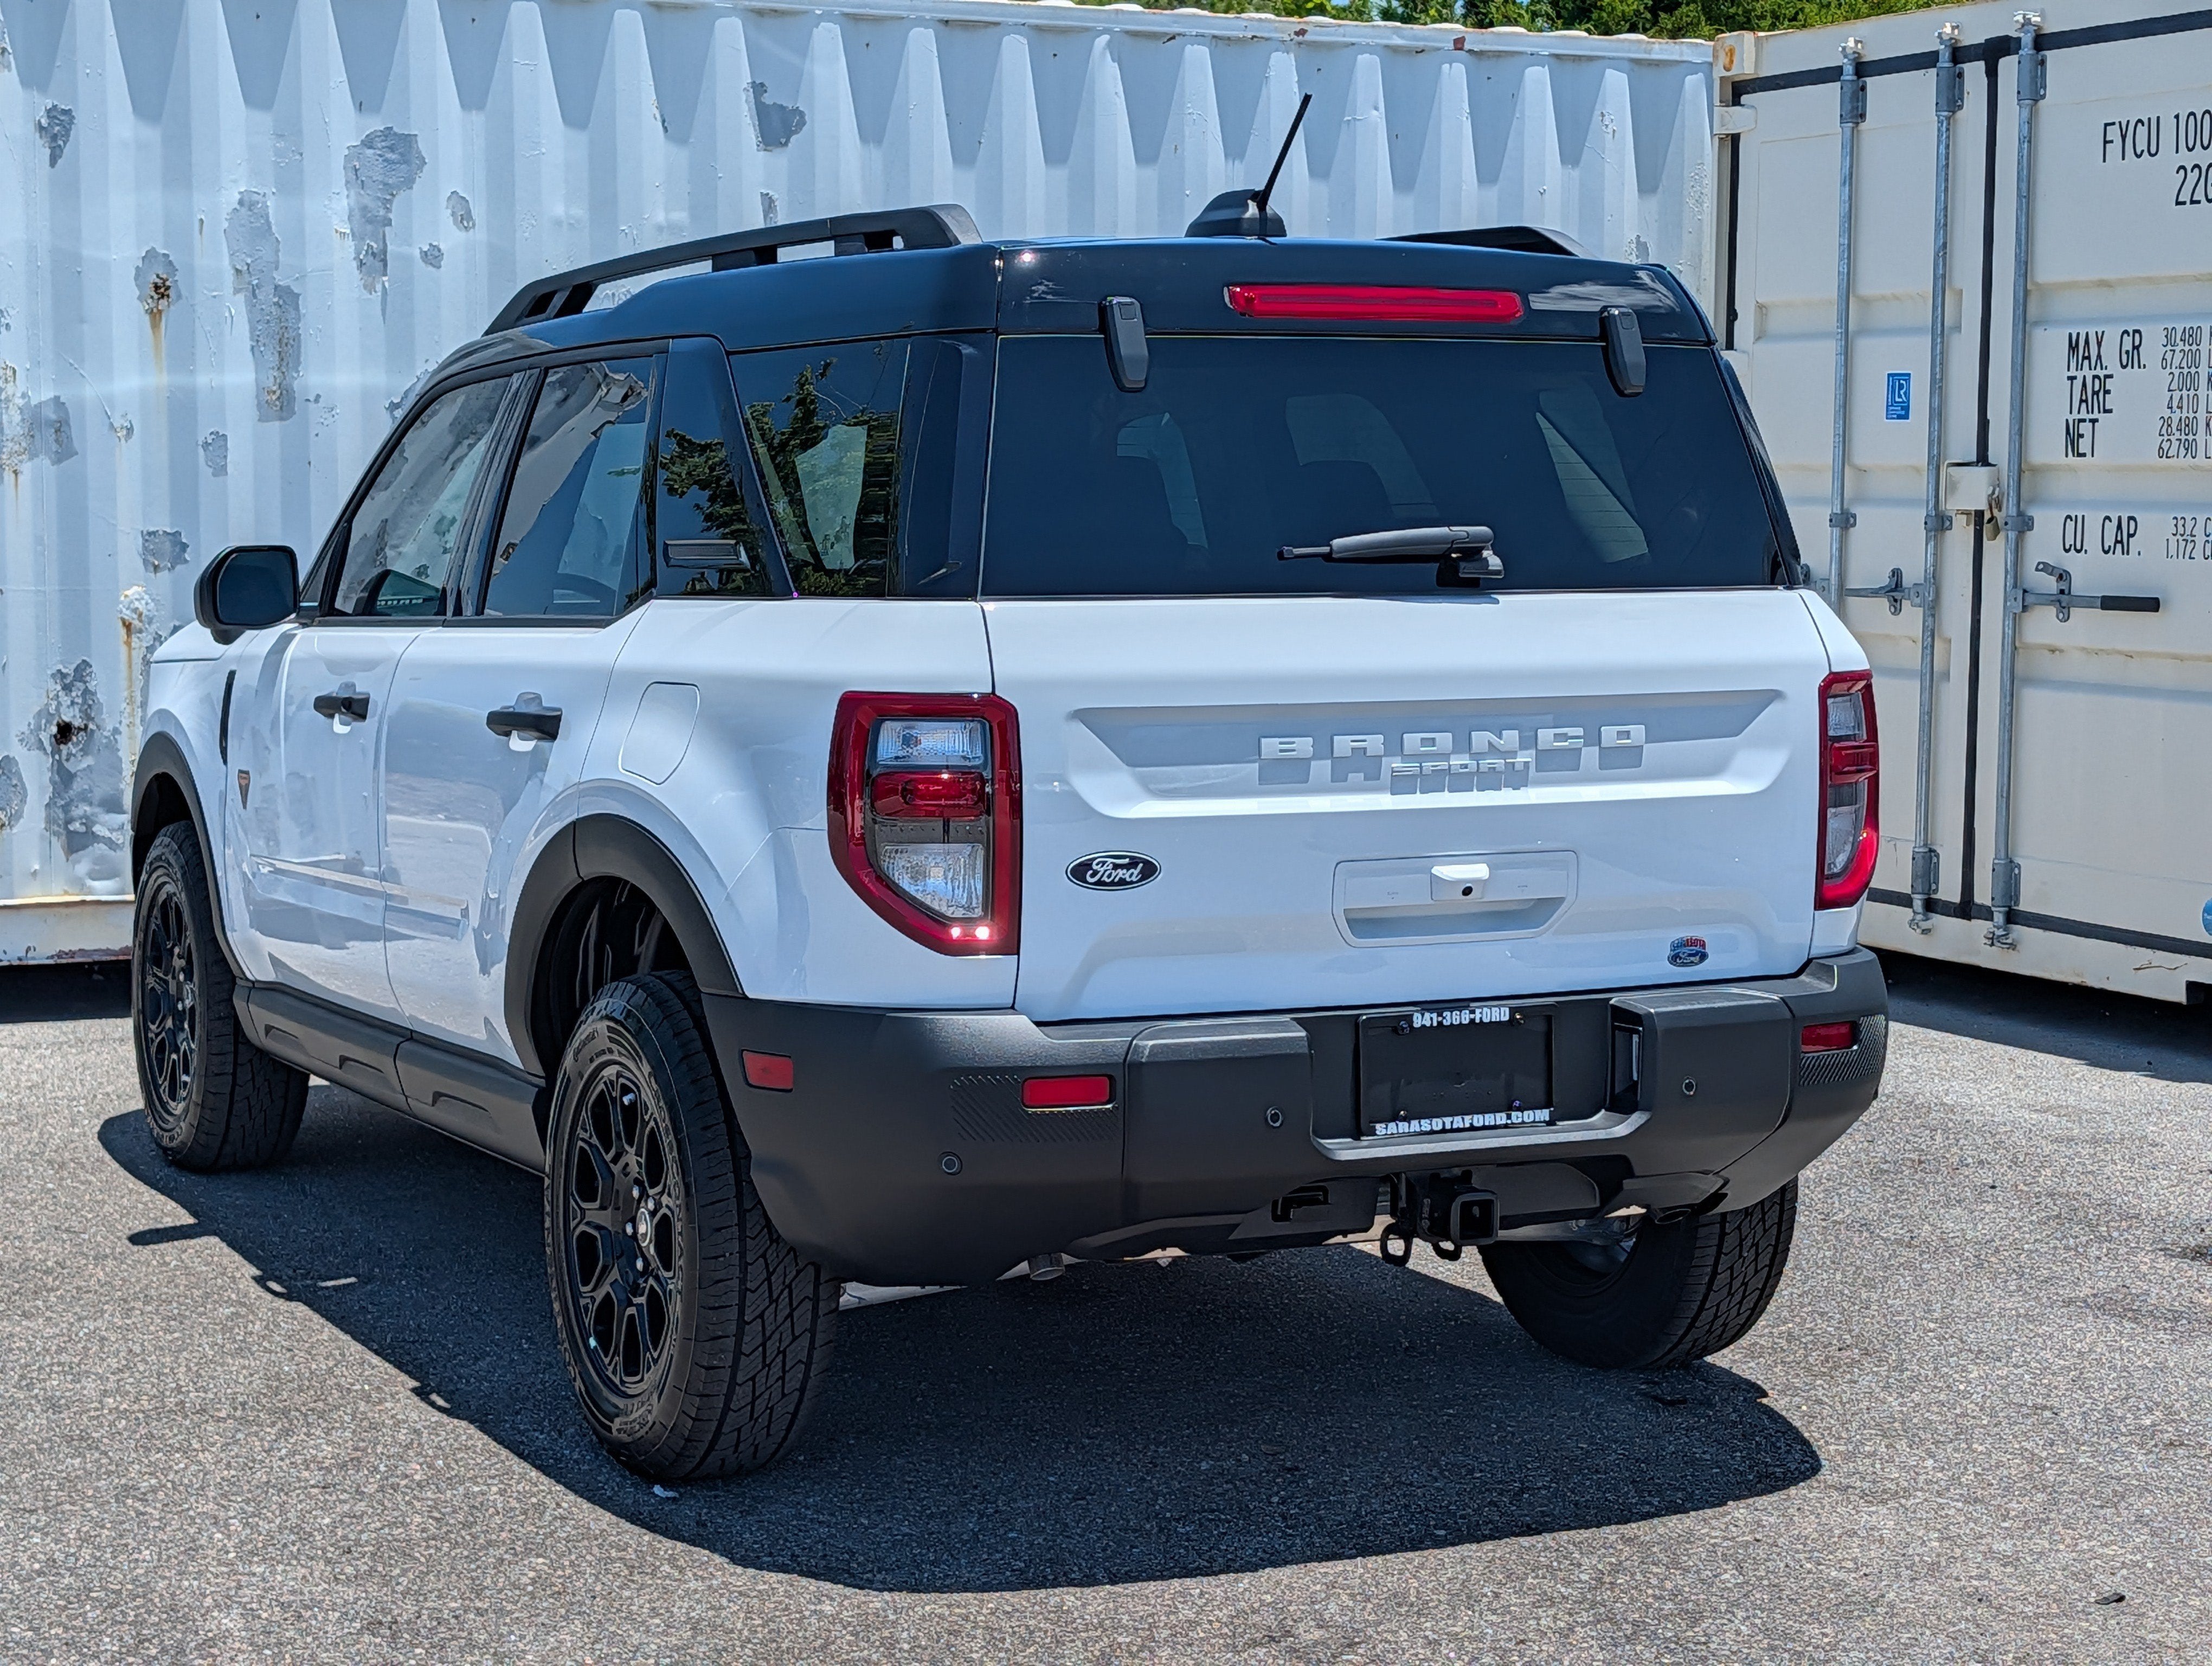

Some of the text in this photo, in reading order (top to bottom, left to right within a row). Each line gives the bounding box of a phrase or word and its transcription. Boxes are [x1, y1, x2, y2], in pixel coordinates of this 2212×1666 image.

[2102, 116, 2160, 163] FYCU
[2162, 325, 2202, 347] 30.480
[2067, 329, 2146, 372] MAX. GR.
[2161, 348, 2201, 370] 67.200
[2067, 374, 2113, 415] TARE
[2065, 418, 2099, 458] NET
[2158, 415, 2198, 437] 28.480
[2062, 514, 2141, 556] CU. CAP.
[2171, 516, 2197, 537] 33.2
[2166, 538, 2196, 560] 1,172
[1258, 724, 1646, 759] BRONCO
[1391, 758, 1532, 776] SPORT
[1086, 857, 1143, 883] Ford
[1413, 1007, 1510, 1028] 941-366-FORD
[1375, 1109, 1550, 1135] SARASOTAFORD.COM
